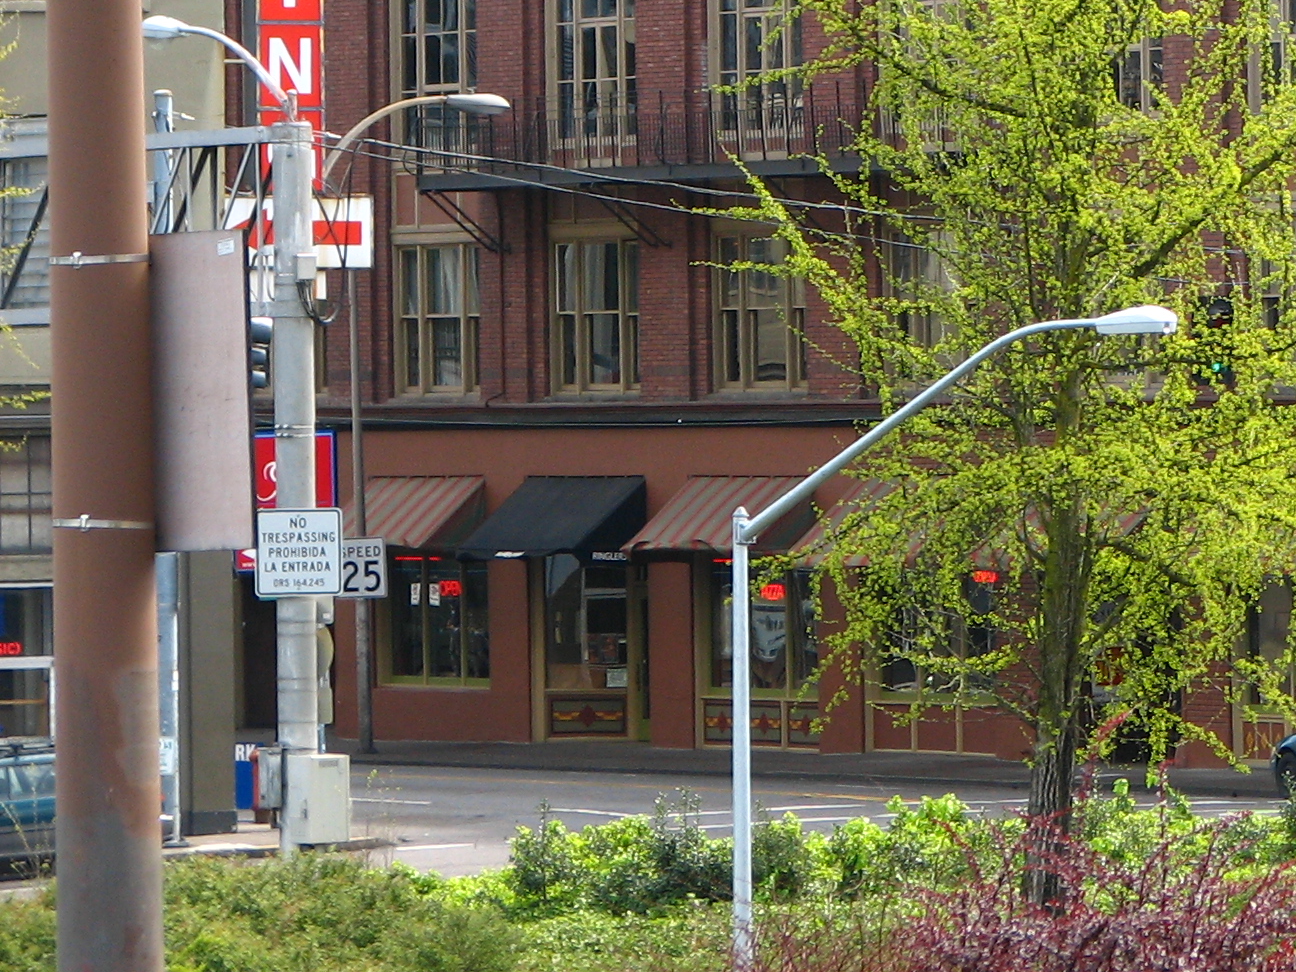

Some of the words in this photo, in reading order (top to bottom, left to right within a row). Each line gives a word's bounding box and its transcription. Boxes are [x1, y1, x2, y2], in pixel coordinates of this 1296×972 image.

[289, 517, 308, 529] NO
[262, 532, 337, 544] TRESPASSING
[268, 547, 327, 558] PROHIBIDA
[264, 562, 277, 573] LA
[281, 561, 332, 573] ENTRADA
[343, 560, 382, 593] 25
[273, 579, 290, 588] ORS
